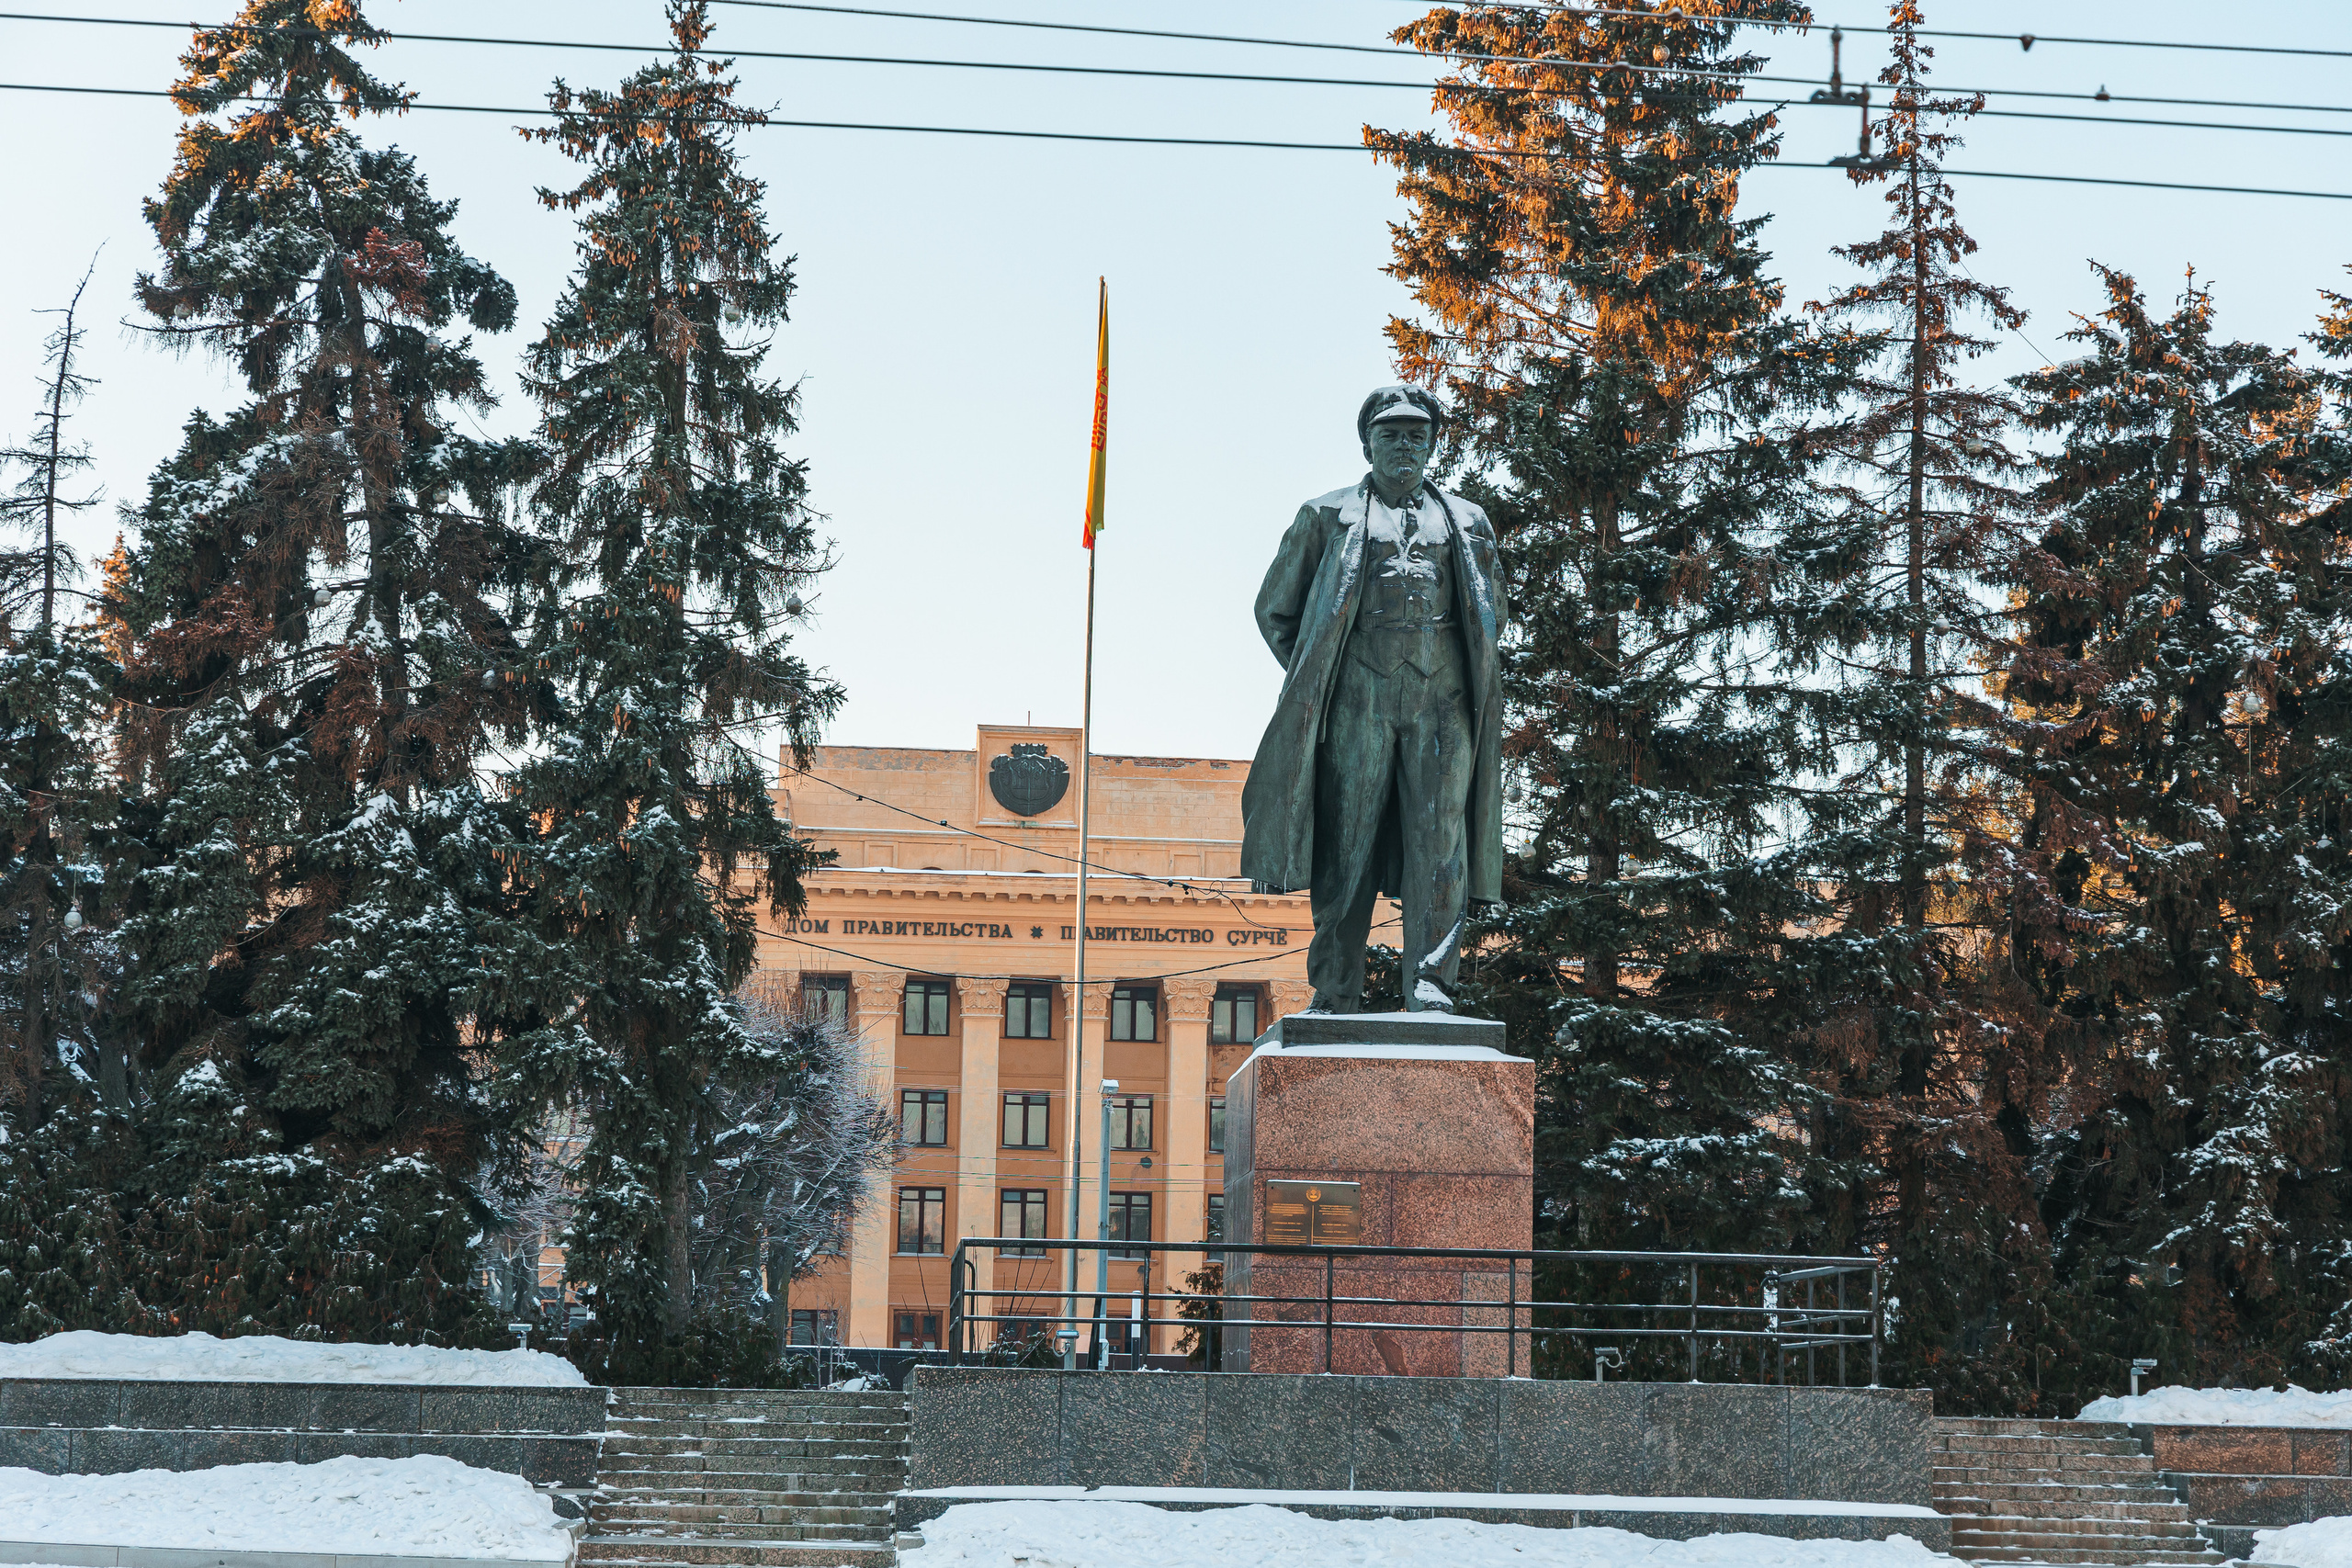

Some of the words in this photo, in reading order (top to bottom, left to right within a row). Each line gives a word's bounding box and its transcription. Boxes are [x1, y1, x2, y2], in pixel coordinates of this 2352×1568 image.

[785, 919, 830, 934] ДОМ
[842, 919, 1013, 938] ПРАВИТЕЛЬСТВА
[1060, 925, 1215, 943] ПАВИТЕЛЬСТВО
